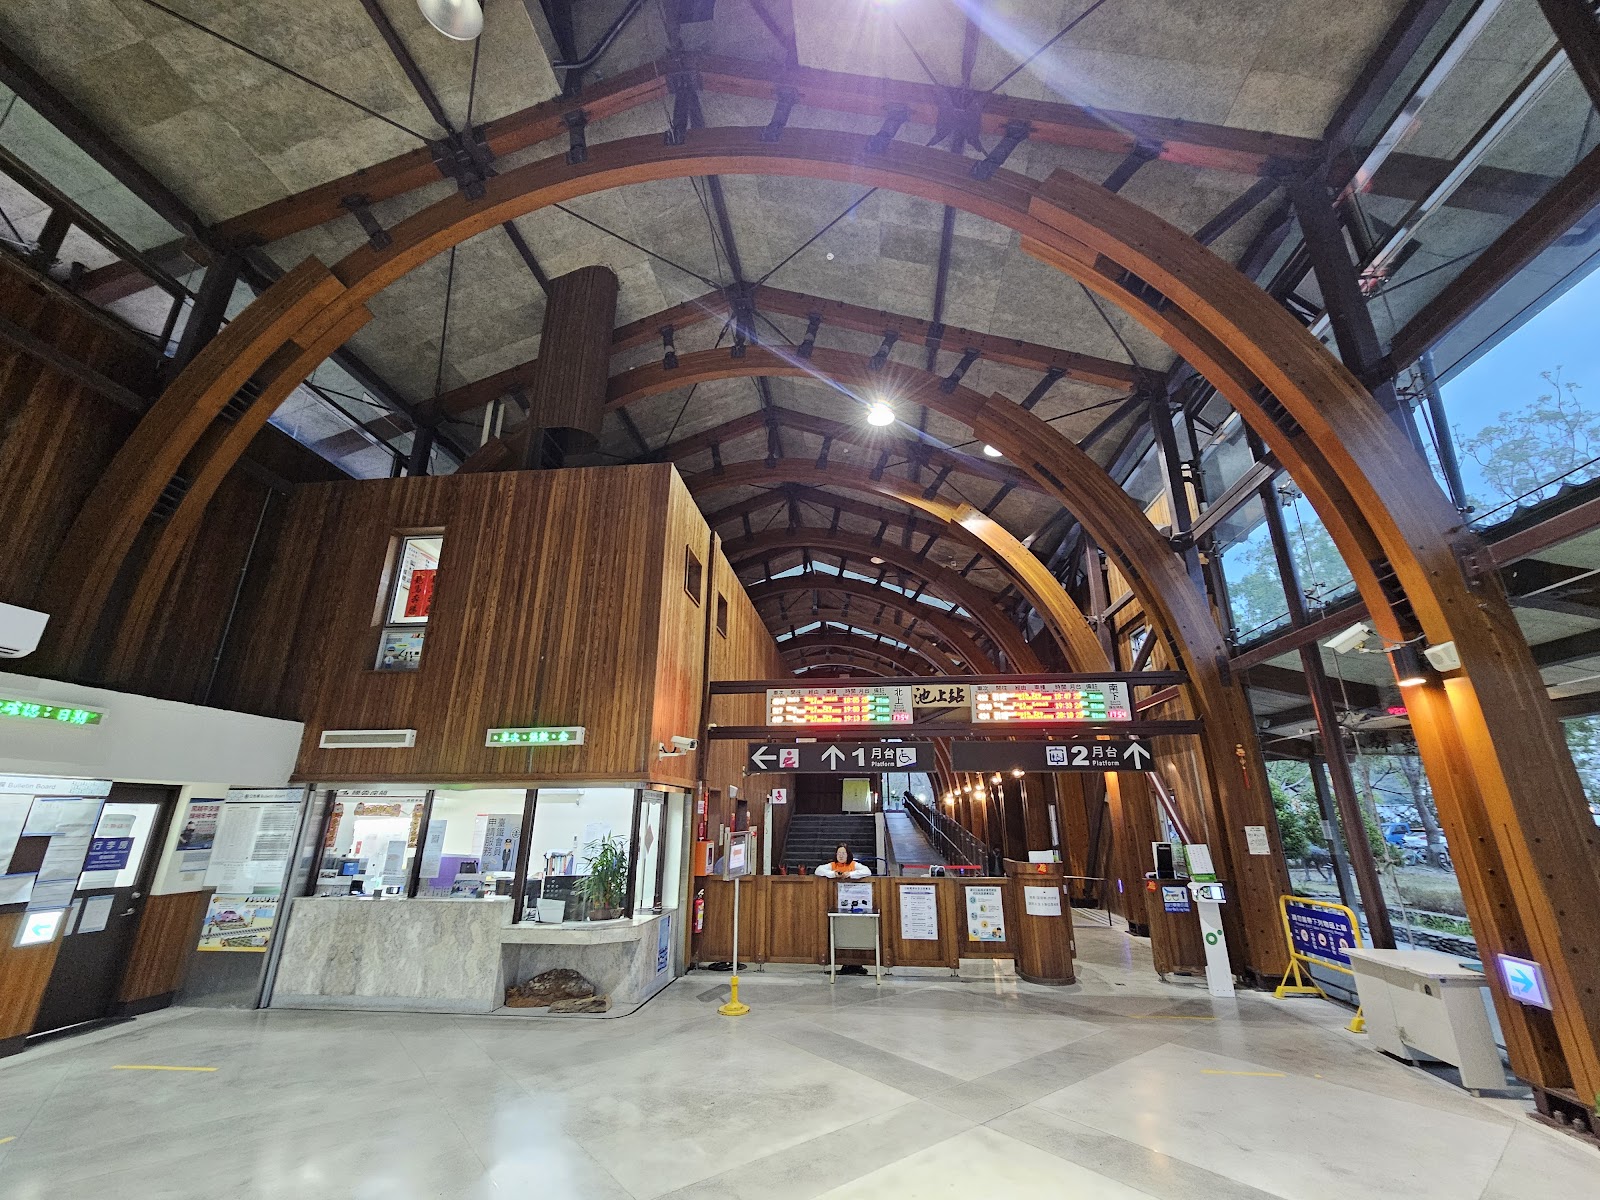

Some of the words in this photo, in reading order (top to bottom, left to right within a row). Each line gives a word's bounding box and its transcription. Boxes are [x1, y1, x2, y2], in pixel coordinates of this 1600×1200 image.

[893, 688, 904, 705] 北上
[913, 687, 965, 705] 池上站
[1108, 684, 1119, 701] 南下
[852, 747, 865, 767] 1
[871, 747, 895, 760] 月台
[871, 760, 895, 768] Platform
[1071, 745, 1090, 766] 2
[1092, 746, 1118, 758] 月台
[1092, 759, 1120, 767] Platform
